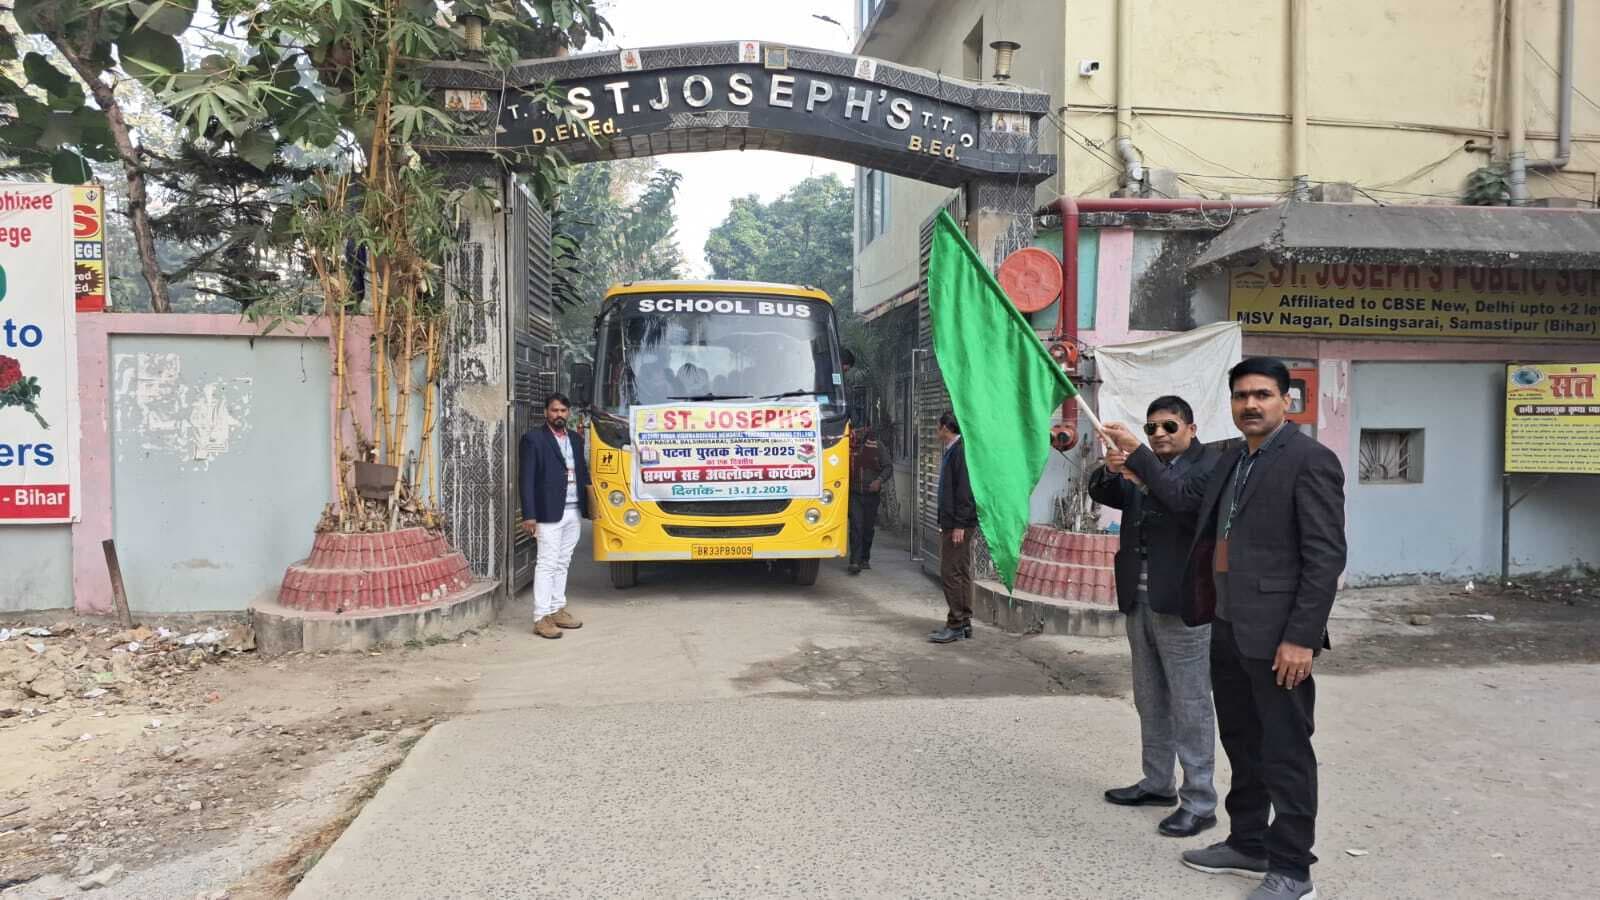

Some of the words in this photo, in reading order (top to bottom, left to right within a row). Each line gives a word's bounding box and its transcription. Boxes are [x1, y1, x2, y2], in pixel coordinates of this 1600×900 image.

[567, 81, 641, 120] ST.
[648, 72, 913, 130] JOSEPH'S
[908, 134, 960, 161] B.Ed.
[639, 298, 750, 314] SCHOOL
[758, 301, 811, 318] BUS
[1279, 294, 1354, 309] Affiliated
[1361, 297, 1377, 310] to
[1382, 297, 1425, 311] CBSE
[1431, 299, 1470, 315] New,
[1475, 300, 1515, 314] Delhi
[1520, 302, 1555, 317] upto
[1560, 303, 1579, 315] +2
[3, 318, 43, 348] to
[1236, 311, 1274, 325] MSV
[1279, 312, 1333, 329] Nagar,
[1339, 313, 1444, 331] Dalsingsarai,
[1449, 316, 1539, 334] Samastipur
[1543, 318, 1597, 335] (Bihar)
[1548, 367, 1597, 399] संत
[663, 410, 696, 430] ST.
[662, 447, 692, 458] पटना
[696, 447, 730, 461] पुस्तक
[15, 488, 65, 506] Bihar
[728, 485, 789, 495] 13.12.2025
